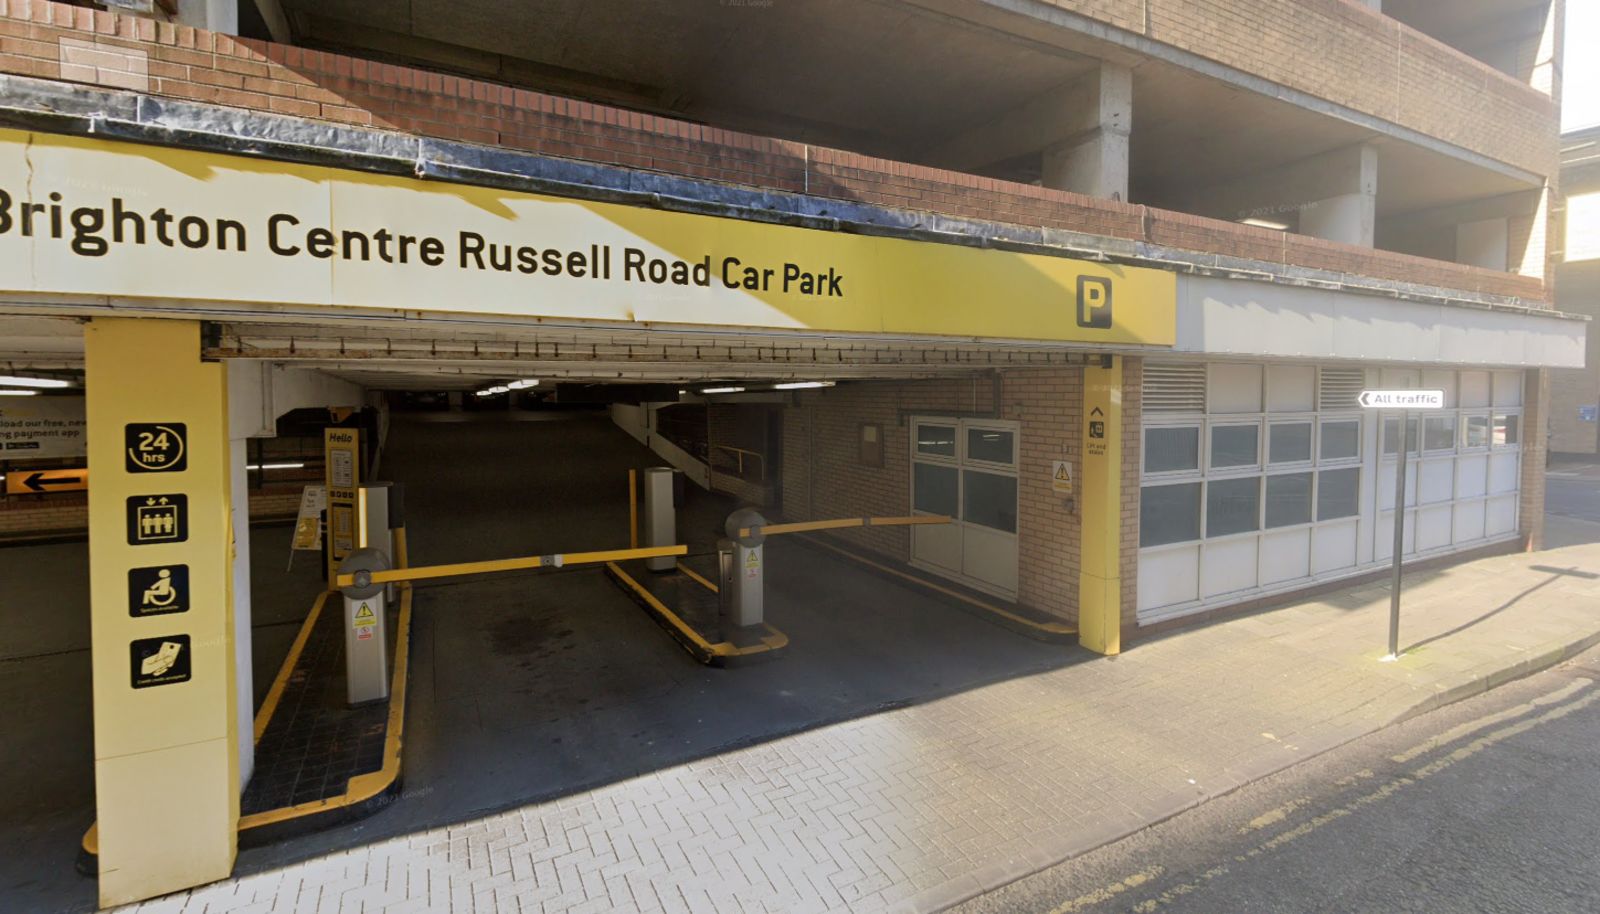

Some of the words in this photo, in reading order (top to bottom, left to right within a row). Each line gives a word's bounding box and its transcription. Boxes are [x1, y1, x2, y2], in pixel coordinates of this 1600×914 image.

[268, 213, 445, 268] Centre
[459, 231, 611, 281] Russell
[624, 247, 711, 287] Road
[722, 256, 775, 292] Car
[783, 263, 844, 298] Park
[1083, 280, 1106, 323] P
[1374, 394, 1391, 404] All
[1396, 394, 1438, 404] traffic
[14, 430, 59, 440] payment
[61, 430, 80, 438] app
[329, 433, 353, 443] Hello
[138, 432, 170, 451] 24
[143, 452, 165, 463] hrs
